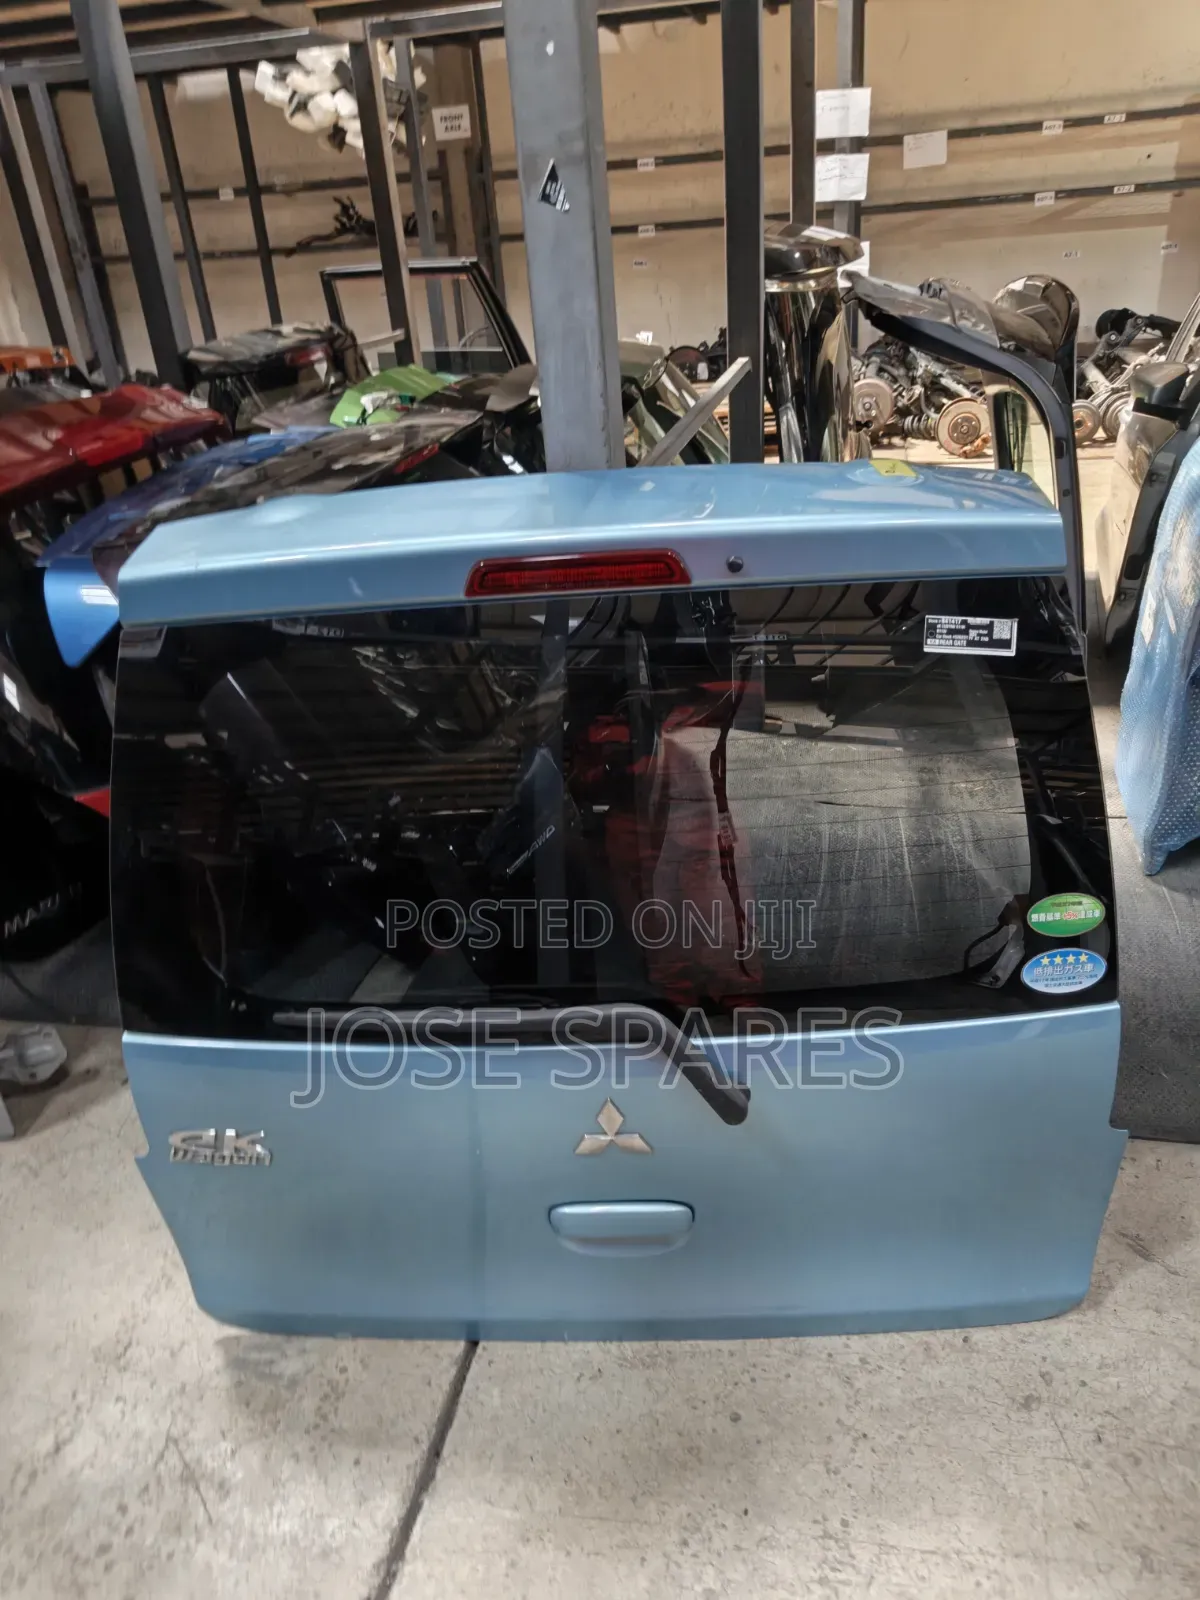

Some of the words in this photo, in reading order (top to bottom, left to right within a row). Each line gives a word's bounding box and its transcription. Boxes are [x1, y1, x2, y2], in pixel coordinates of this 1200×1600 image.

[439, 113, 463, 124] FRONT
[1033, 963, 1095, 977] 低排出ガス車
